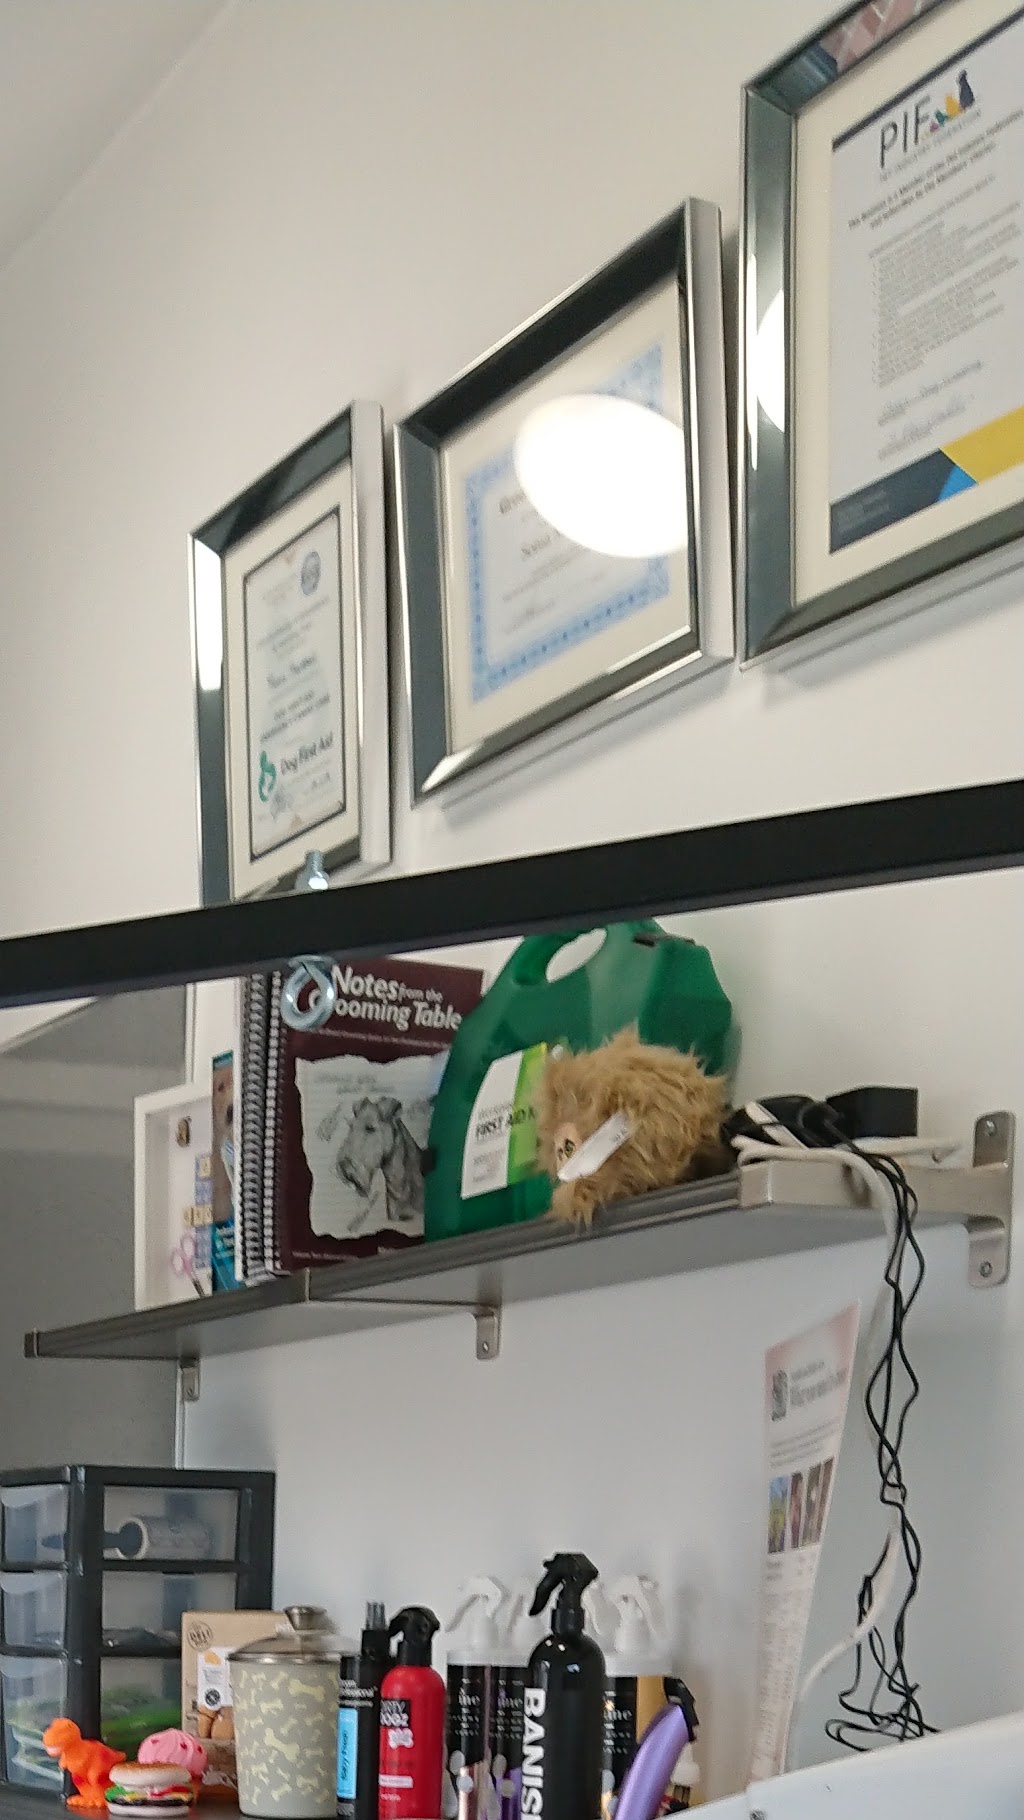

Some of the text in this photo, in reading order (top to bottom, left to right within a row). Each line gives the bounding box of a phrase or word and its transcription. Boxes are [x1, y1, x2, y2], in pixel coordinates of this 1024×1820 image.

[880, 94, 930, 169] PIF
[332, 963, 444, 1003] Notes from the
[413, 1000, 463, 1031] Table
